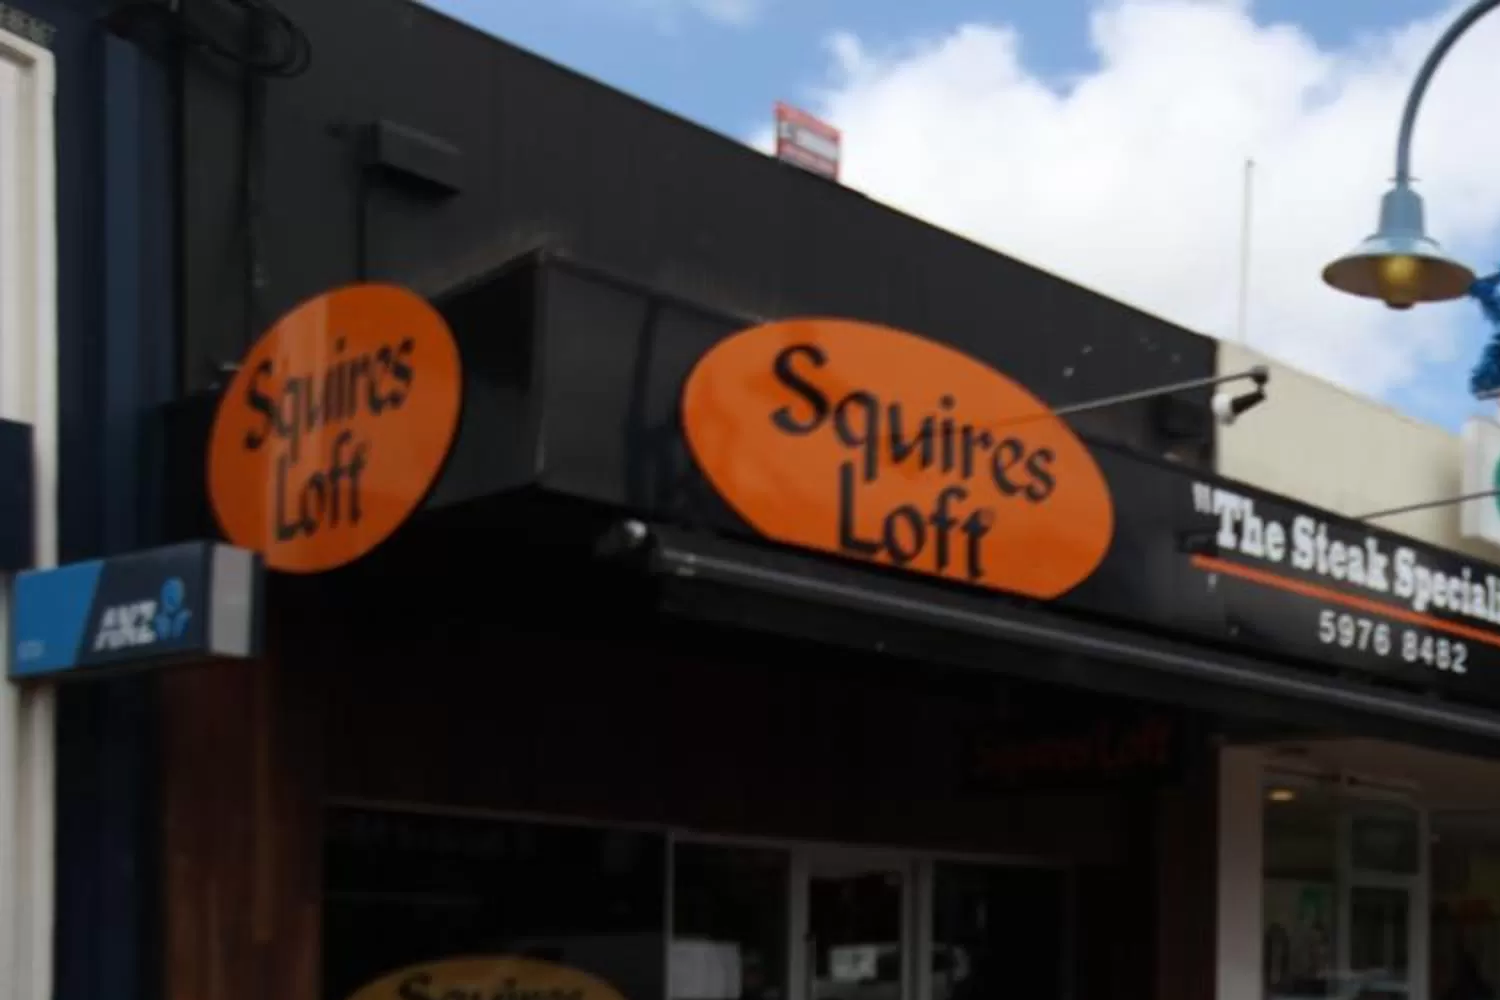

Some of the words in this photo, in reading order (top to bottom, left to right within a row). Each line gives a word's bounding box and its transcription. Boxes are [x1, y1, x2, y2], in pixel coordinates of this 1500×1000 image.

[243, 338, 414, 464] Squires
[769, 342, 1056, 503] Squires
[273, 430, 370, 542] Loft
[838, 460, 996, 581] Loft
[1291, 514, 1390, 592] Steak
[1318, 608, 1392, 657] 5976
[1401, 628, 1469, 675] 8482
